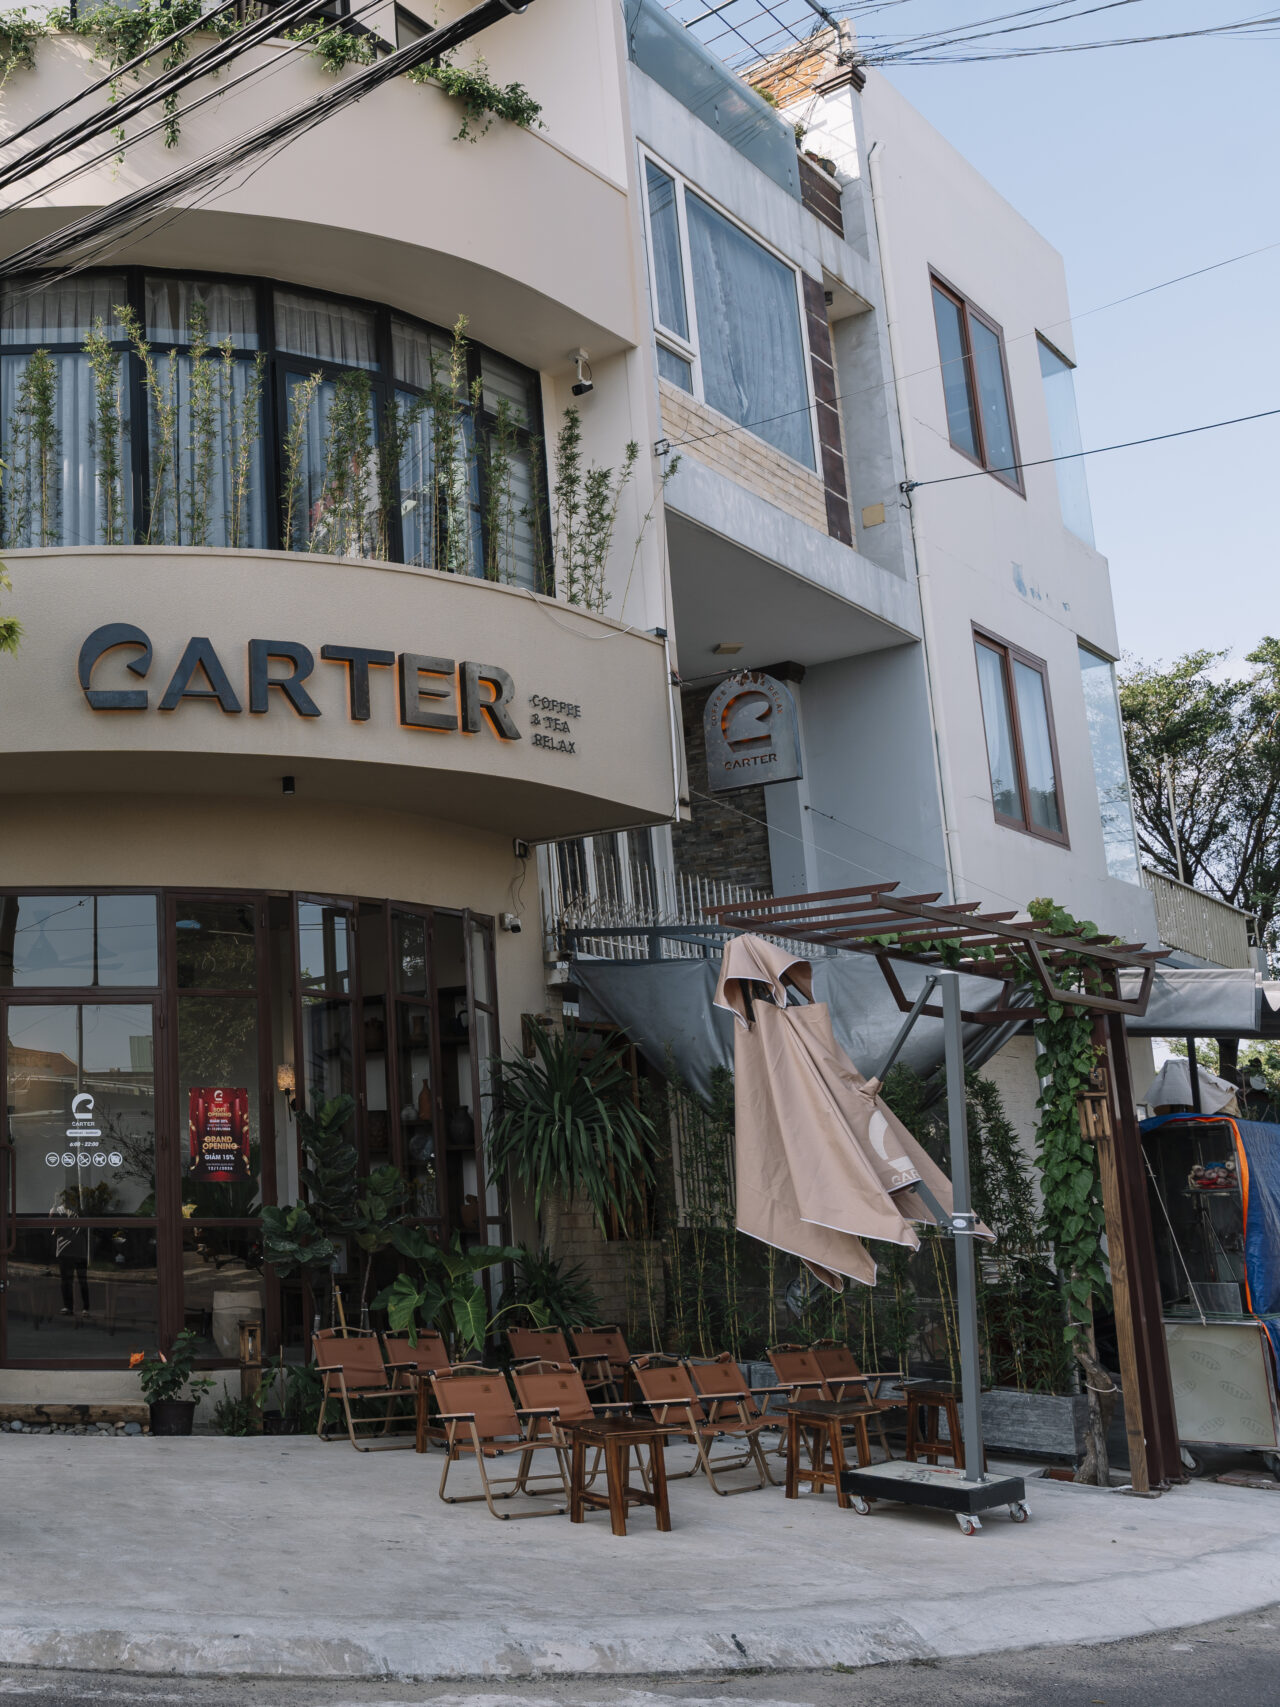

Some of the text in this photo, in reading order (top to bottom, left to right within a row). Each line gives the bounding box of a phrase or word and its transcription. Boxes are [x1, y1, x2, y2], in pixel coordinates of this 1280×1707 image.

[78, 622, 521, 741] CARTER
[531, 694, 582, 718] COFFEE
[531, 713, 570, 733] & TEA
[532, 733, 576, 753] RELAX
[724, 753, 778, 771] CARTER
